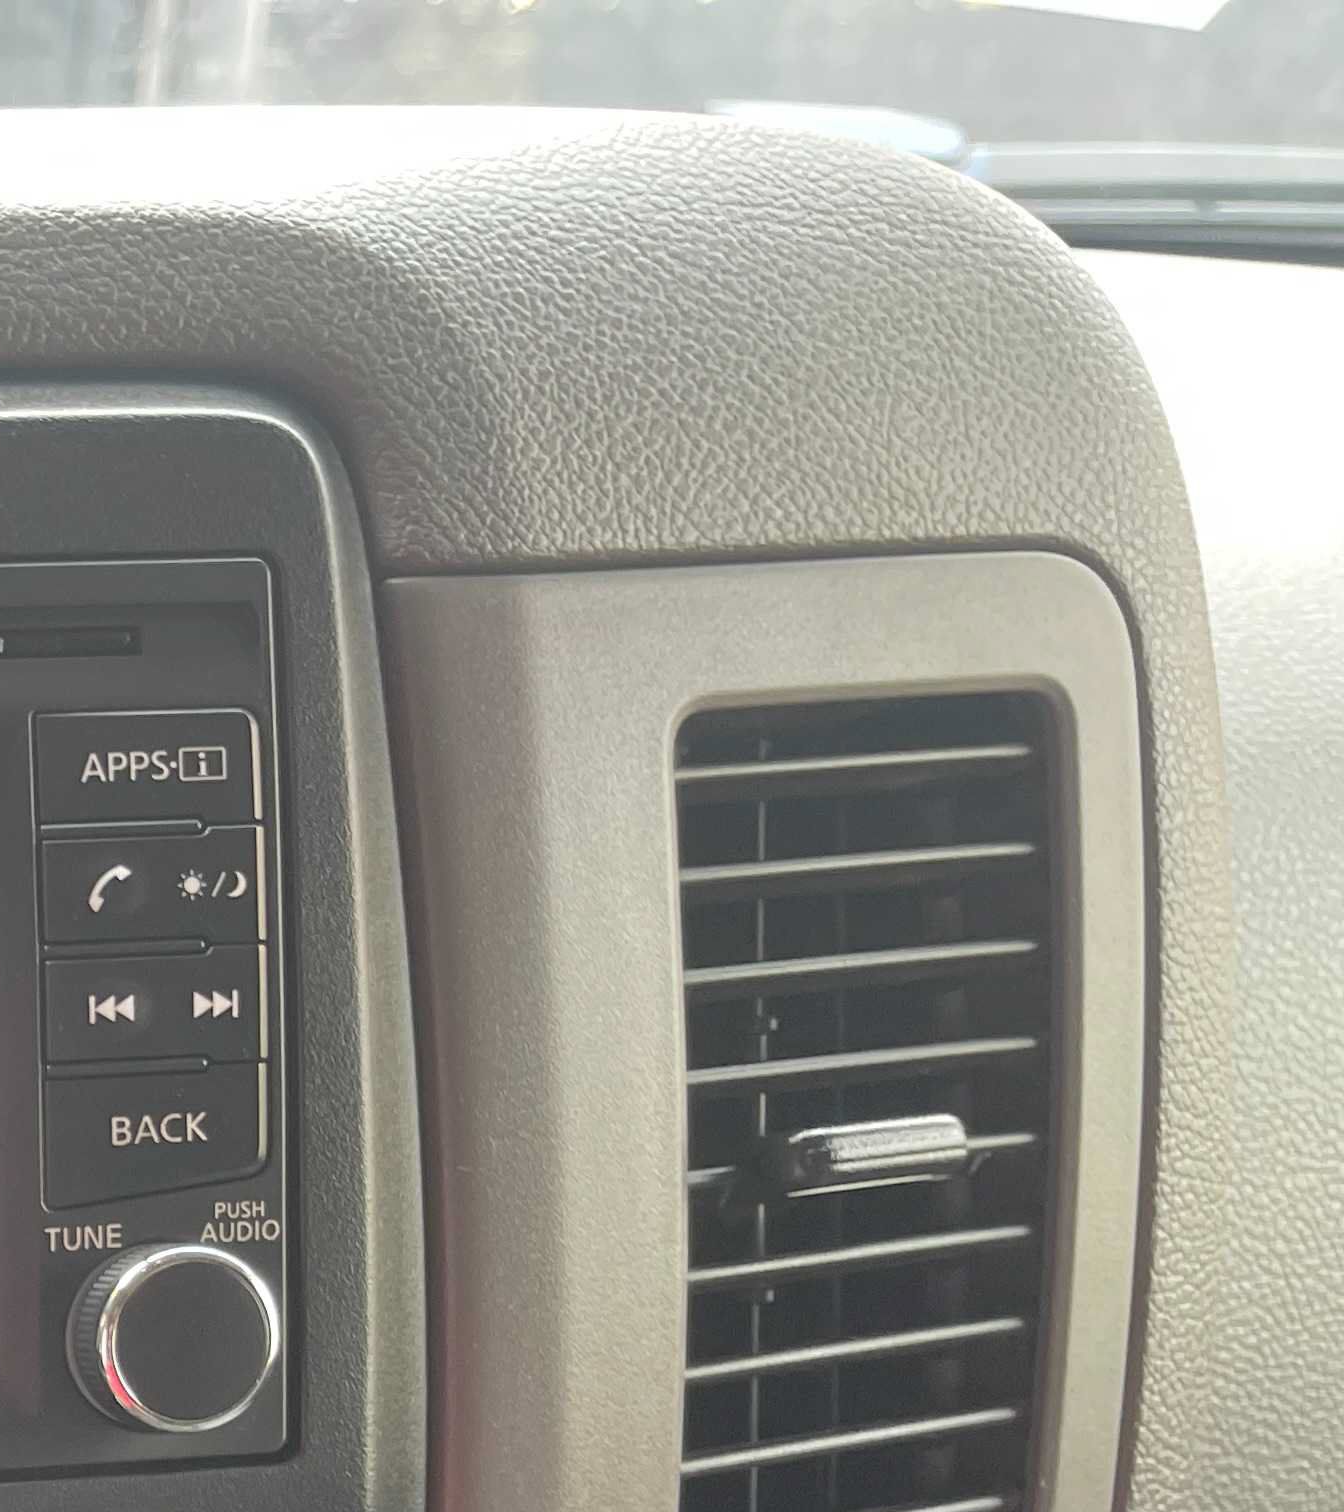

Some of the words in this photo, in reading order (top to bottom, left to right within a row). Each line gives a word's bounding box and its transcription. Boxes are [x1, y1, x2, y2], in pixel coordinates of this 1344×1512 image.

[111, 1111, 208, 1147] BACK
[214, 1200, 265, 1219] PUSH
[44, 1223, 123, 1252] TUNE
[200, 1219, 280, 1243] AUDIO
